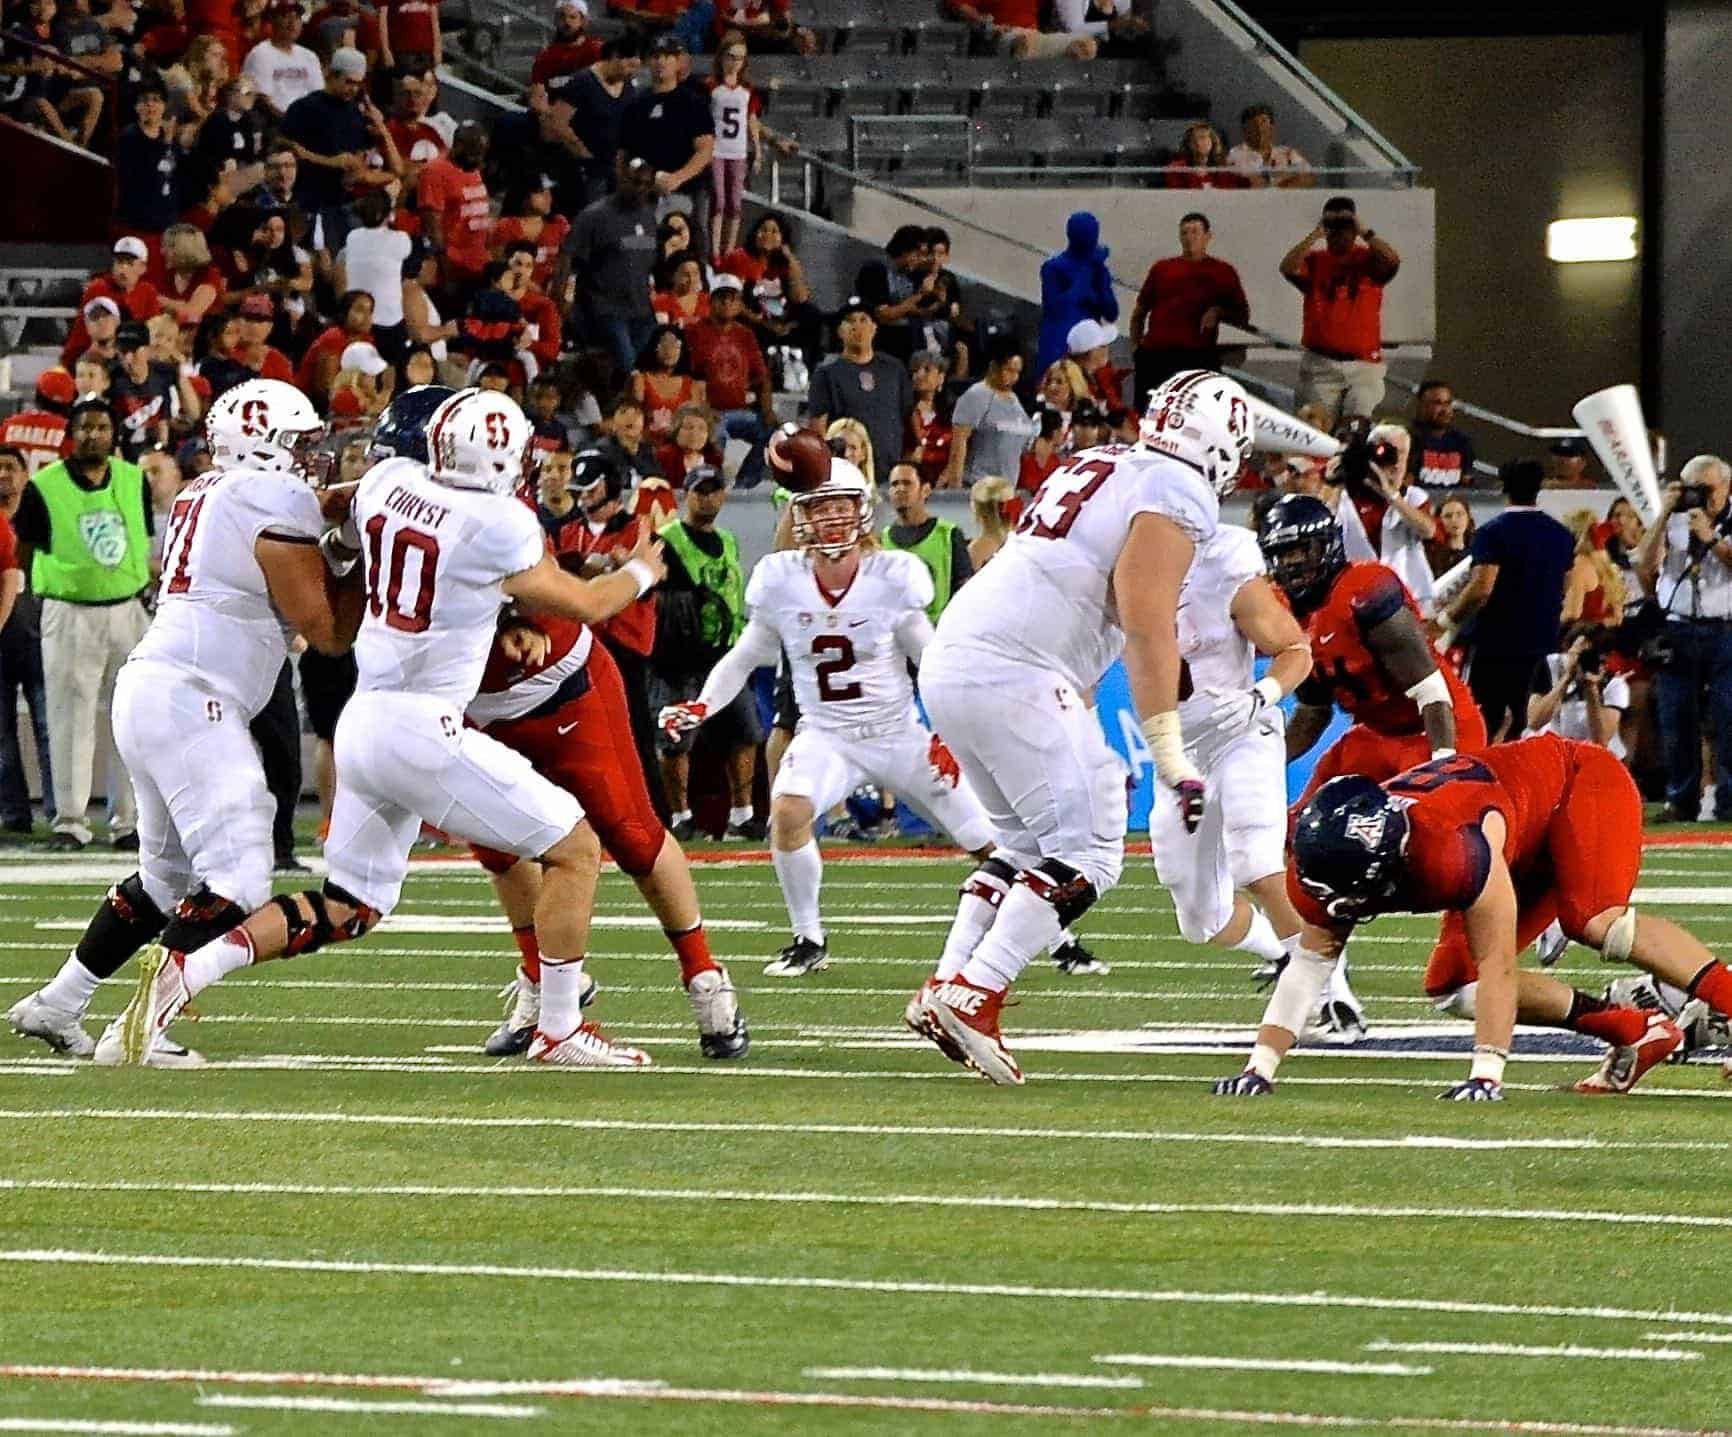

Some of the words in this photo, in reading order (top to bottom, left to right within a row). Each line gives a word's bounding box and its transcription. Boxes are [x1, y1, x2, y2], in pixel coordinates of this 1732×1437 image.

[723, 107, 739, 139] 5
[384, 486, 452, 530] CHRYST
[163, 494, 206, 594] 71
[365, 513, 441, 634] 10
[811, 635, 864, 702] 2
[934, 983, 989, 1017] NIKE
